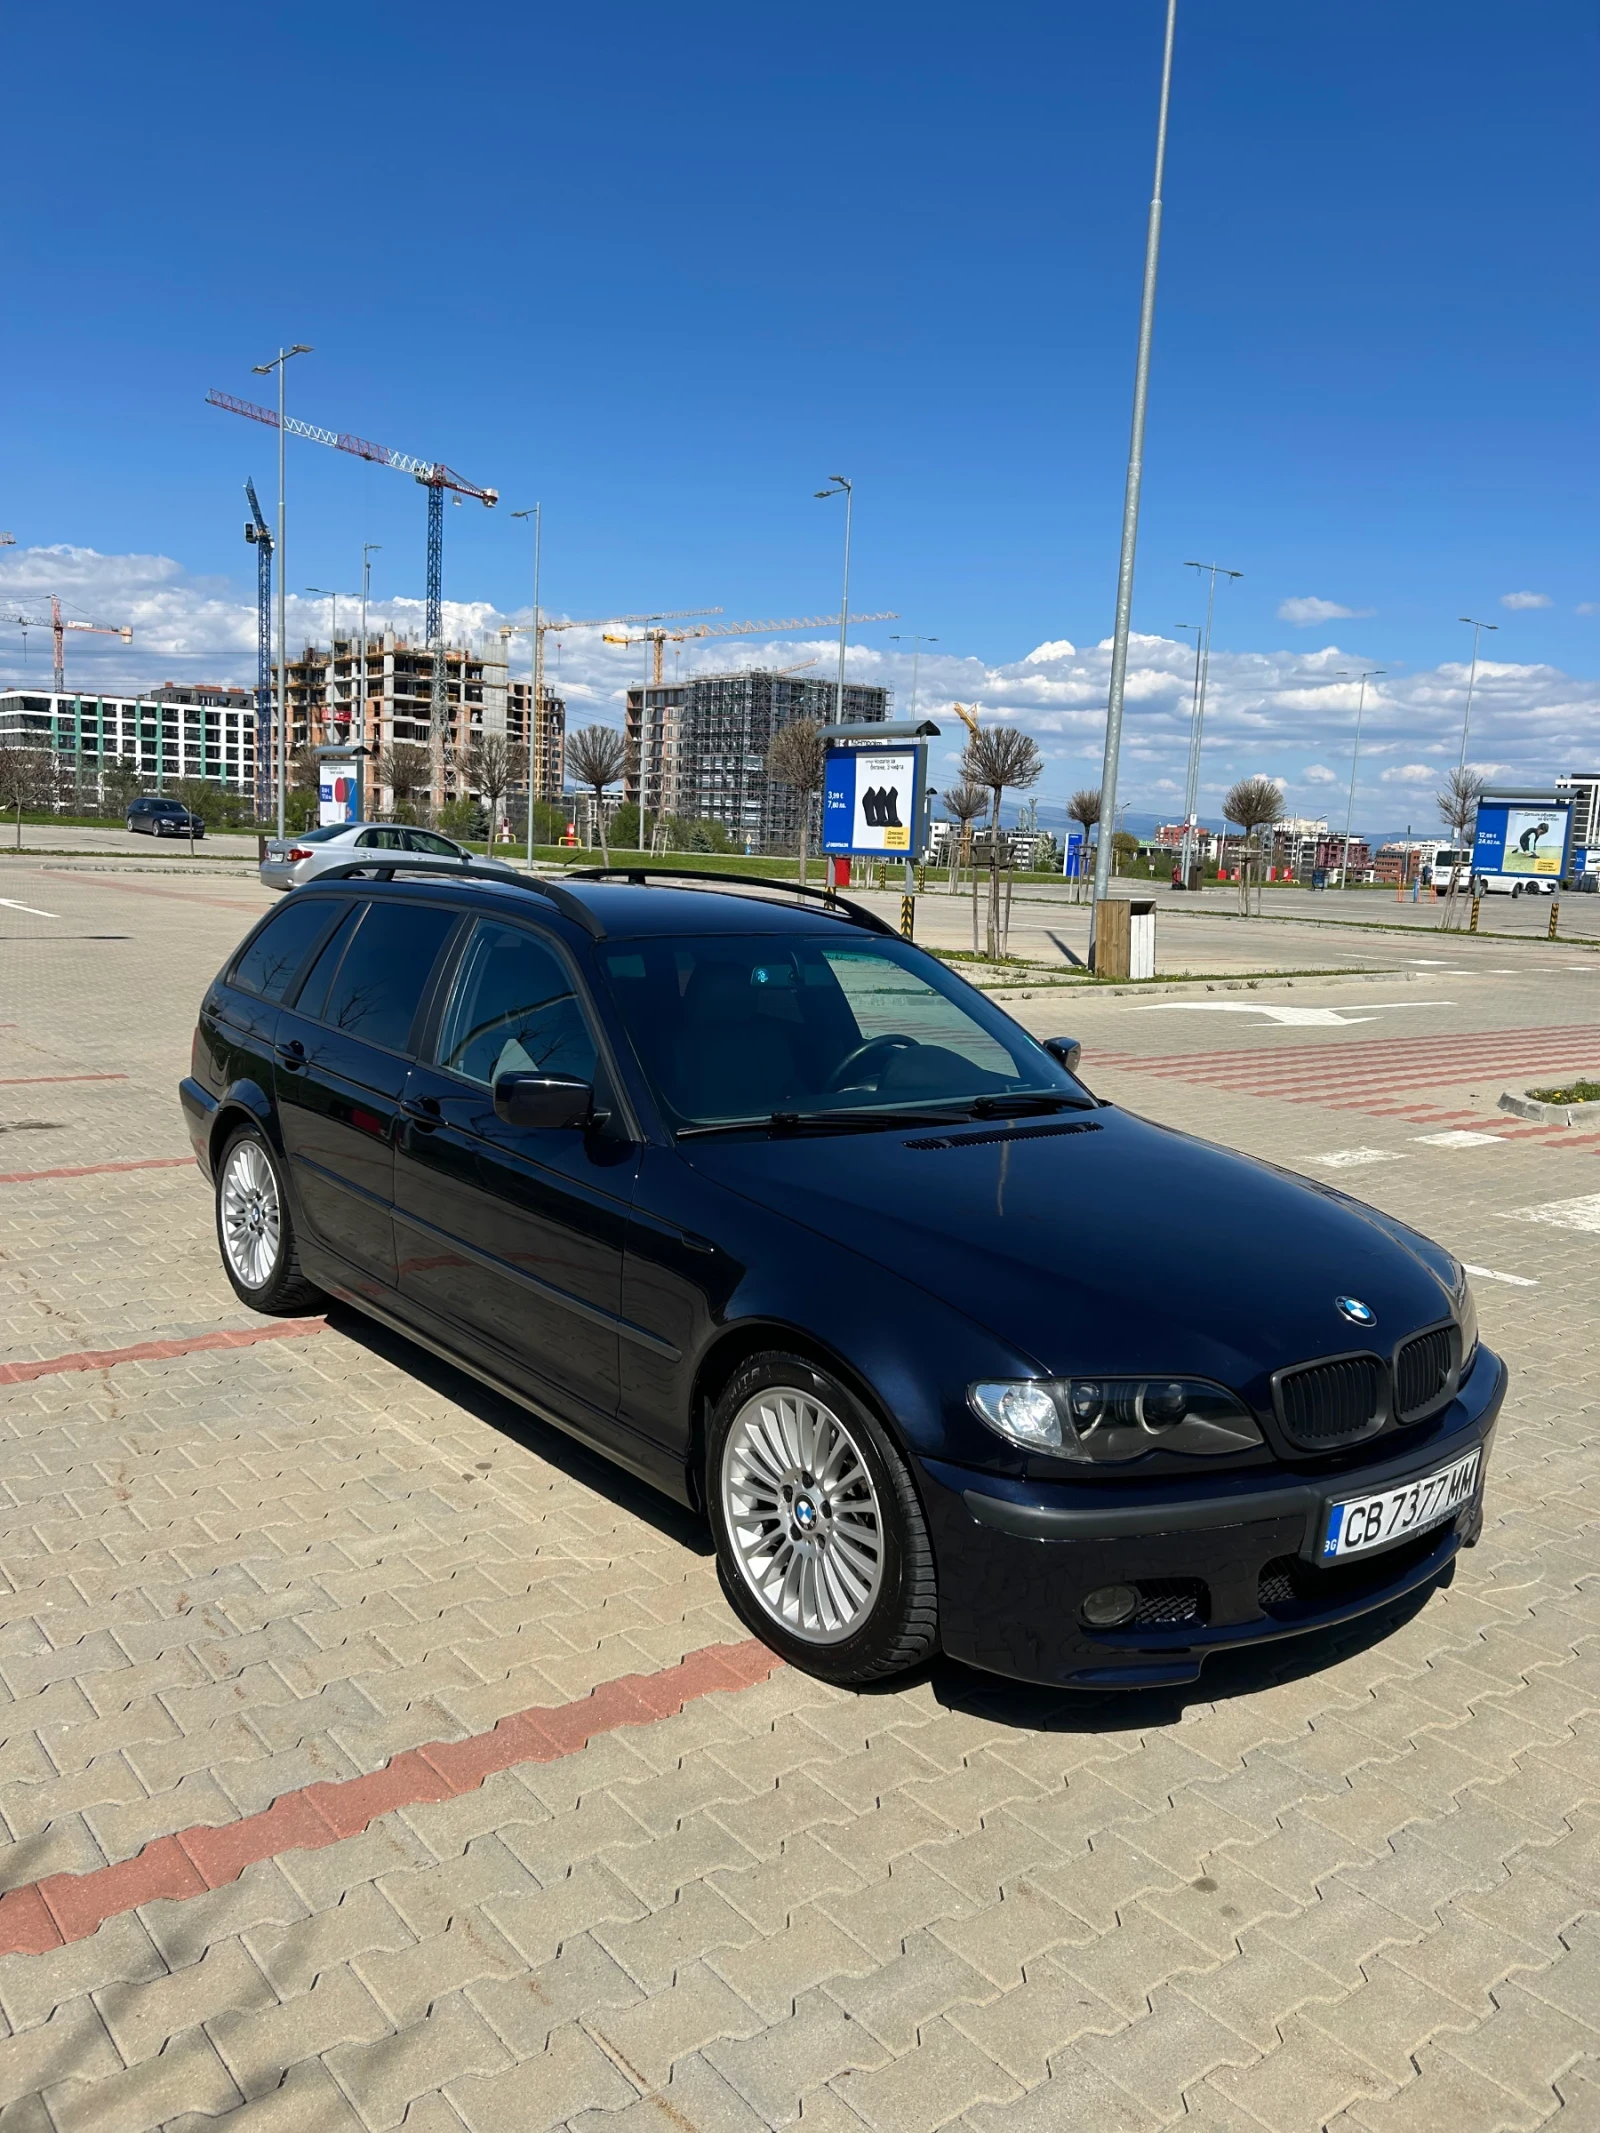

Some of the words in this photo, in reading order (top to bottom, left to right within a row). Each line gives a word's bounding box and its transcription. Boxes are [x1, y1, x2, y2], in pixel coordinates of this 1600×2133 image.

[1344, 1501, 1384, 1548] CB
[1385, 1474, 1450, 1536] 7377
[1445, 1456, 1477, 1507] MM
